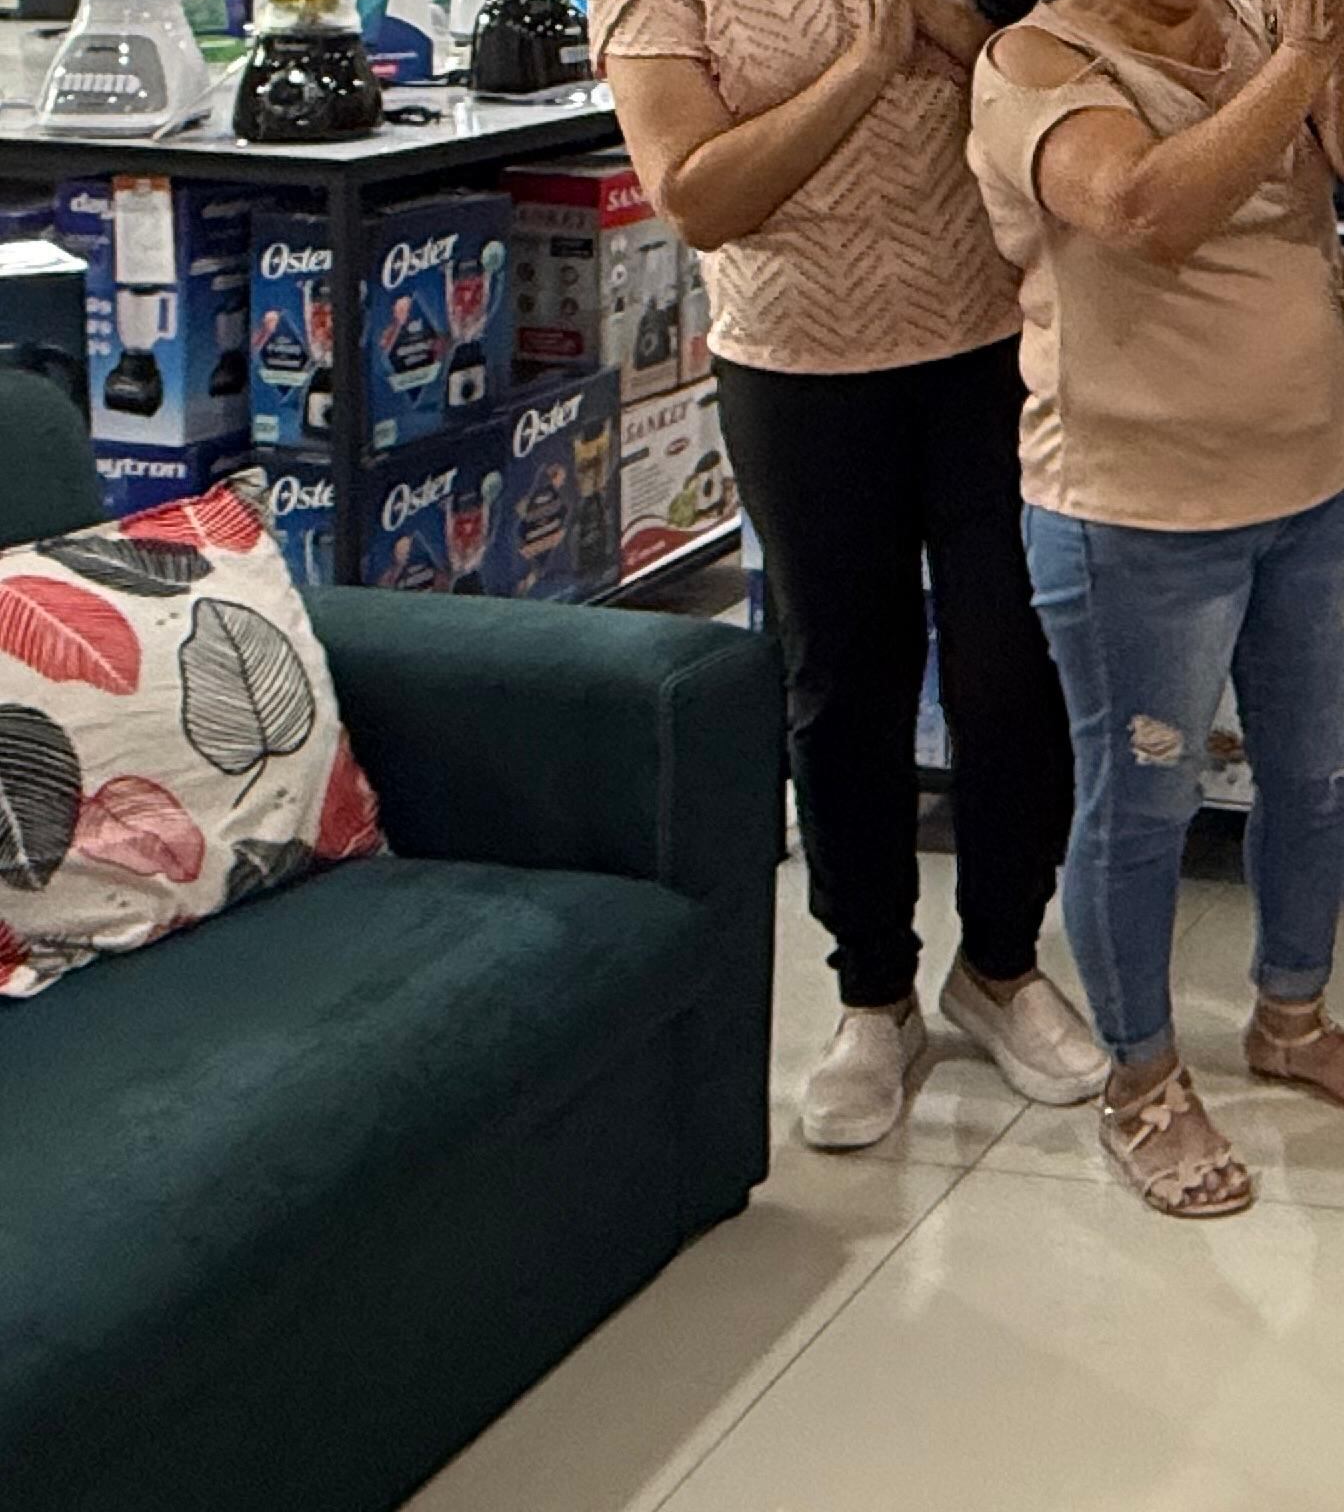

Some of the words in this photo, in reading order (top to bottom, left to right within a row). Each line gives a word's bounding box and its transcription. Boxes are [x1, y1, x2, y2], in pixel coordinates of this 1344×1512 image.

[382, 233, 459, 289] Oster
[512, 394, 584, 458] Oster
[382, 467, 458, 532] Oster
